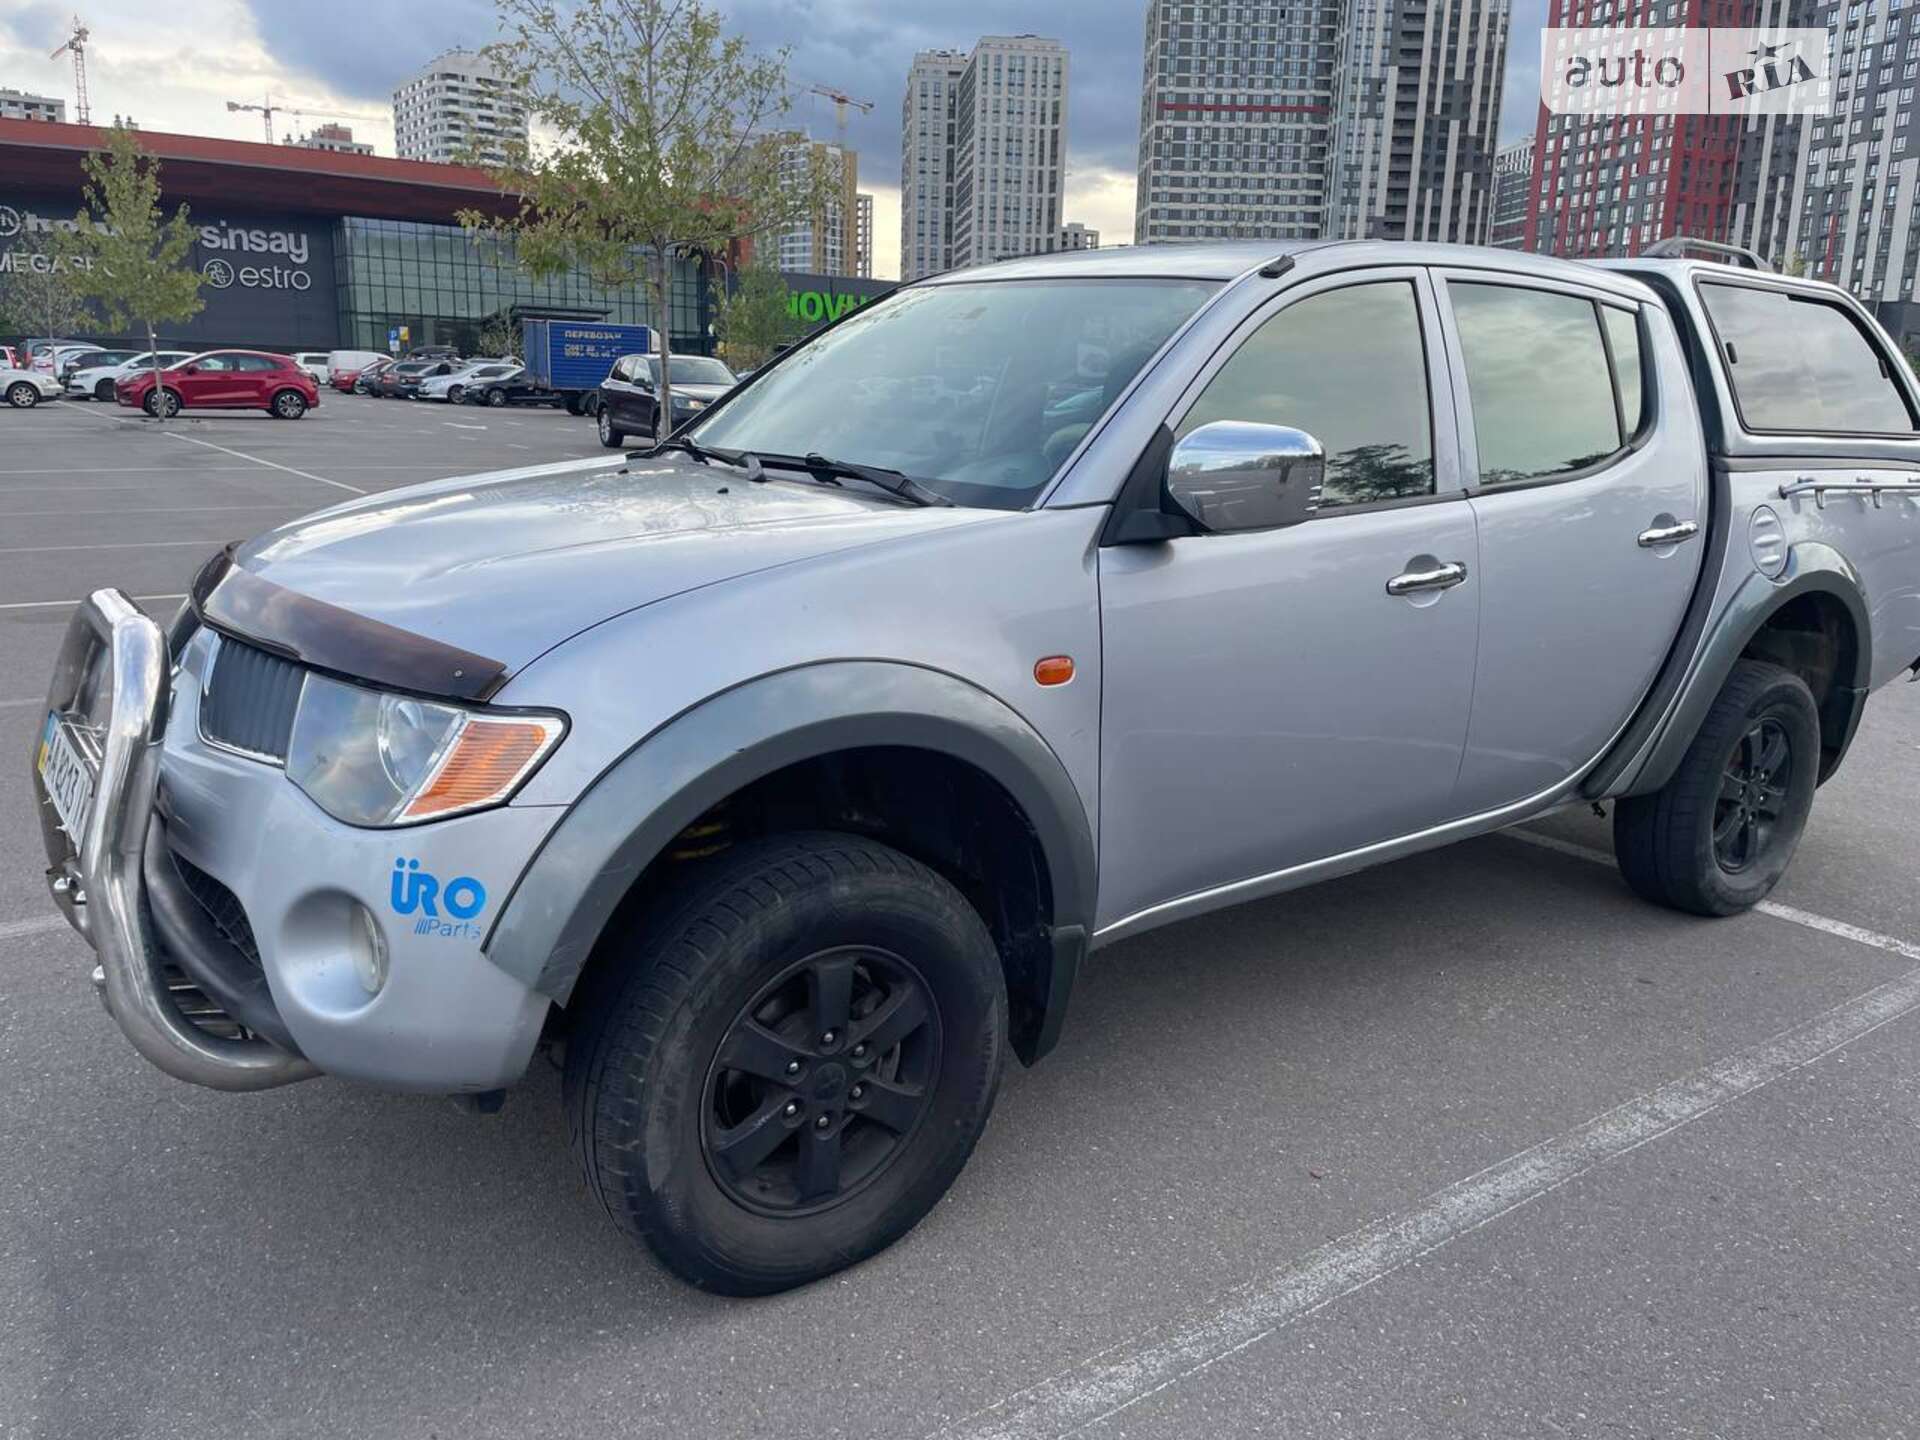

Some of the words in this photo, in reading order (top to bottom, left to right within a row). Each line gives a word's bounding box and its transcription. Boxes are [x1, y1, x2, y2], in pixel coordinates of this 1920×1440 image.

[200, 219, 309, 264] sinsay
[239, 265, 311, 290] estro
[390, 856, 487, 920] ÜRO
